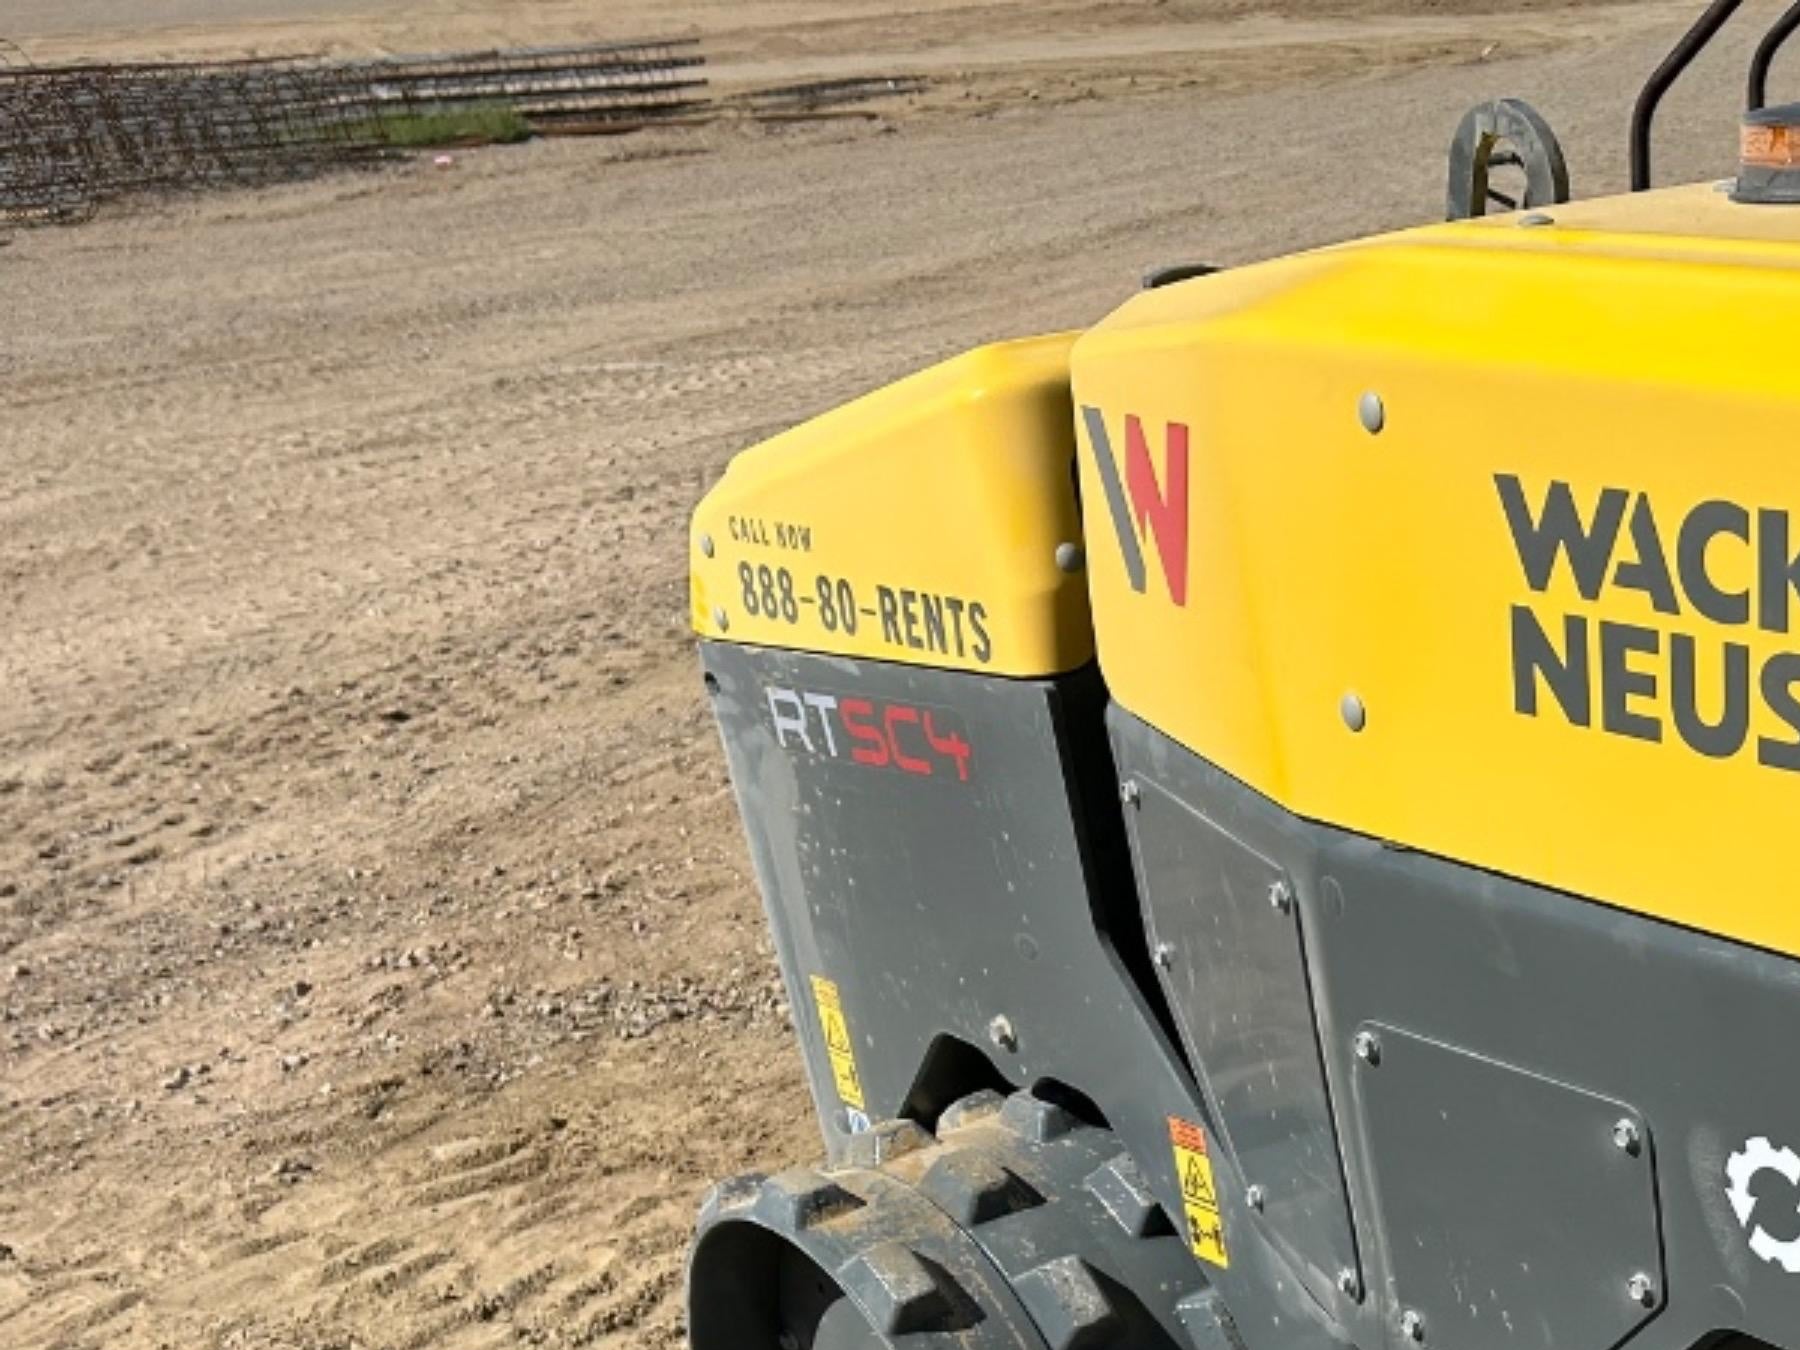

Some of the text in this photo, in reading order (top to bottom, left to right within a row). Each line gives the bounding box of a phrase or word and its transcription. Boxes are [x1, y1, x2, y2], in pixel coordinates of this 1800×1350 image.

[728, 515, 811, 552] CALL NOW
[738, 560, 992, 664] 888-80-RENTS
